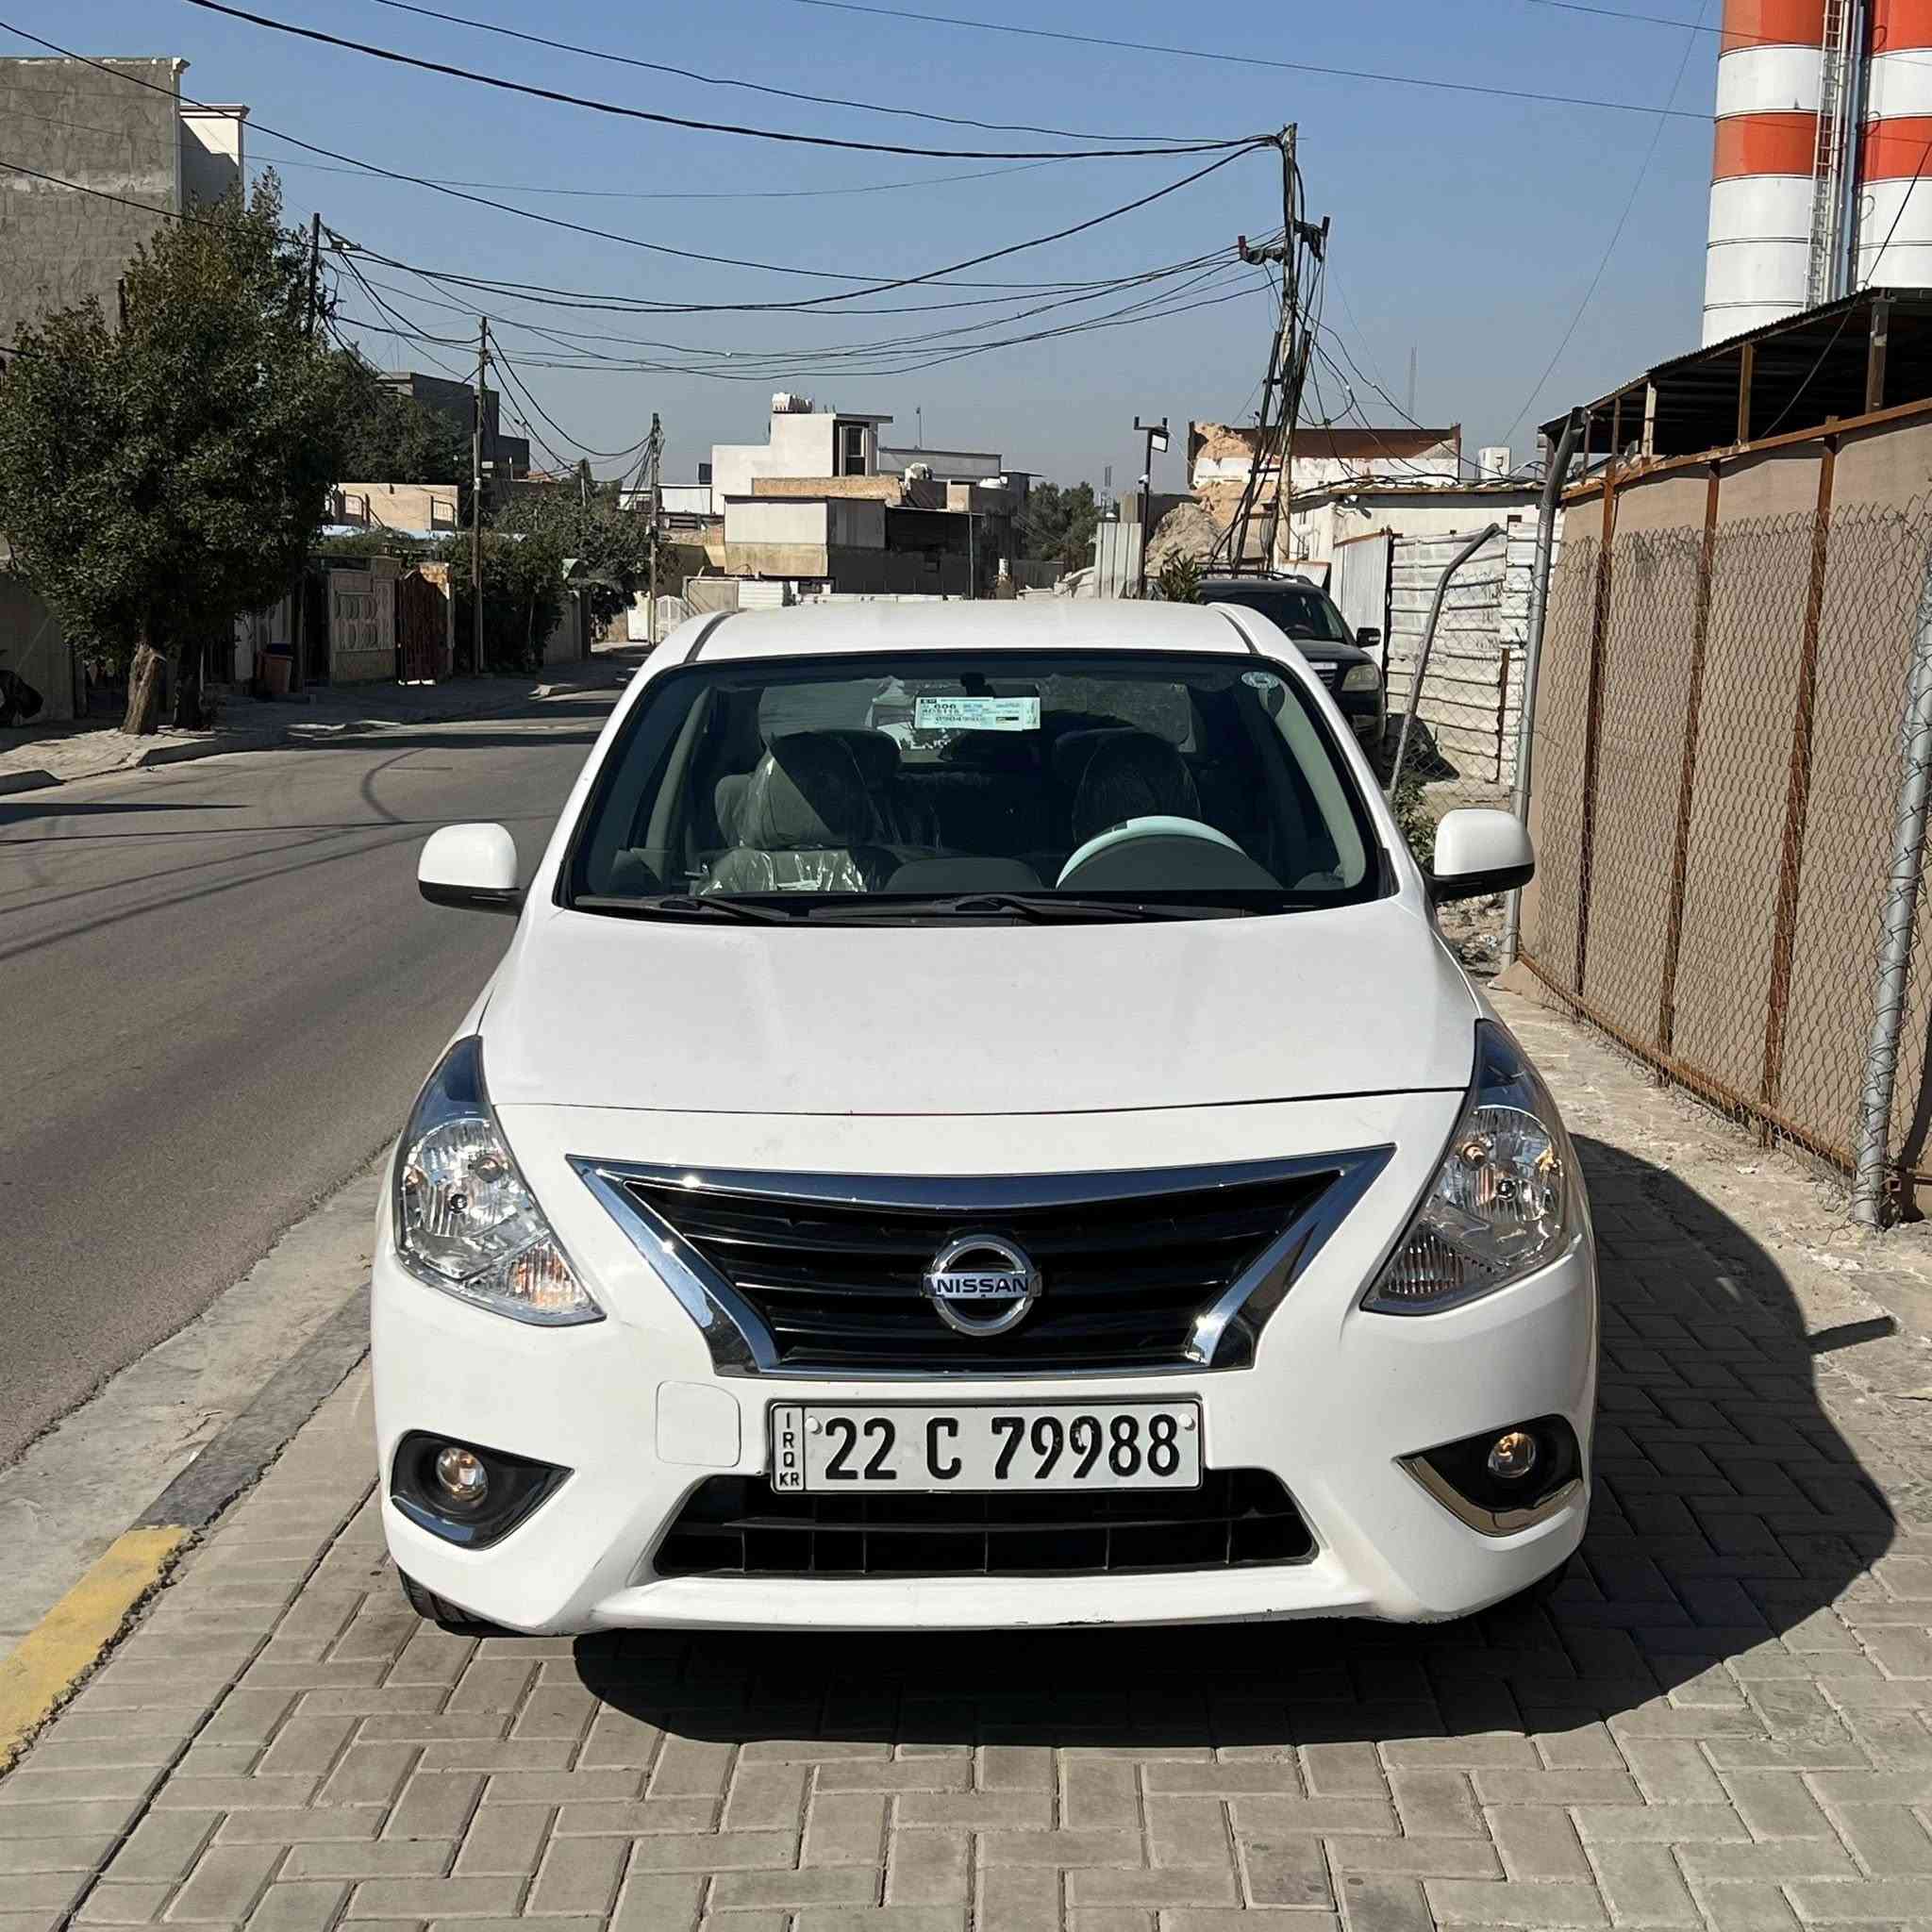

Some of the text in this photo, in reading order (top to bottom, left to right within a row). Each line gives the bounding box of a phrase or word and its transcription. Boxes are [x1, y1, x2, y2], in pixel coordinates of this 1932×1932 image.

[937, 1278, 1028, 1293] NISSAN
[824, 1413, 1180, 1480] 22 C 79988
[778, 1471, 800, 1487] KR
